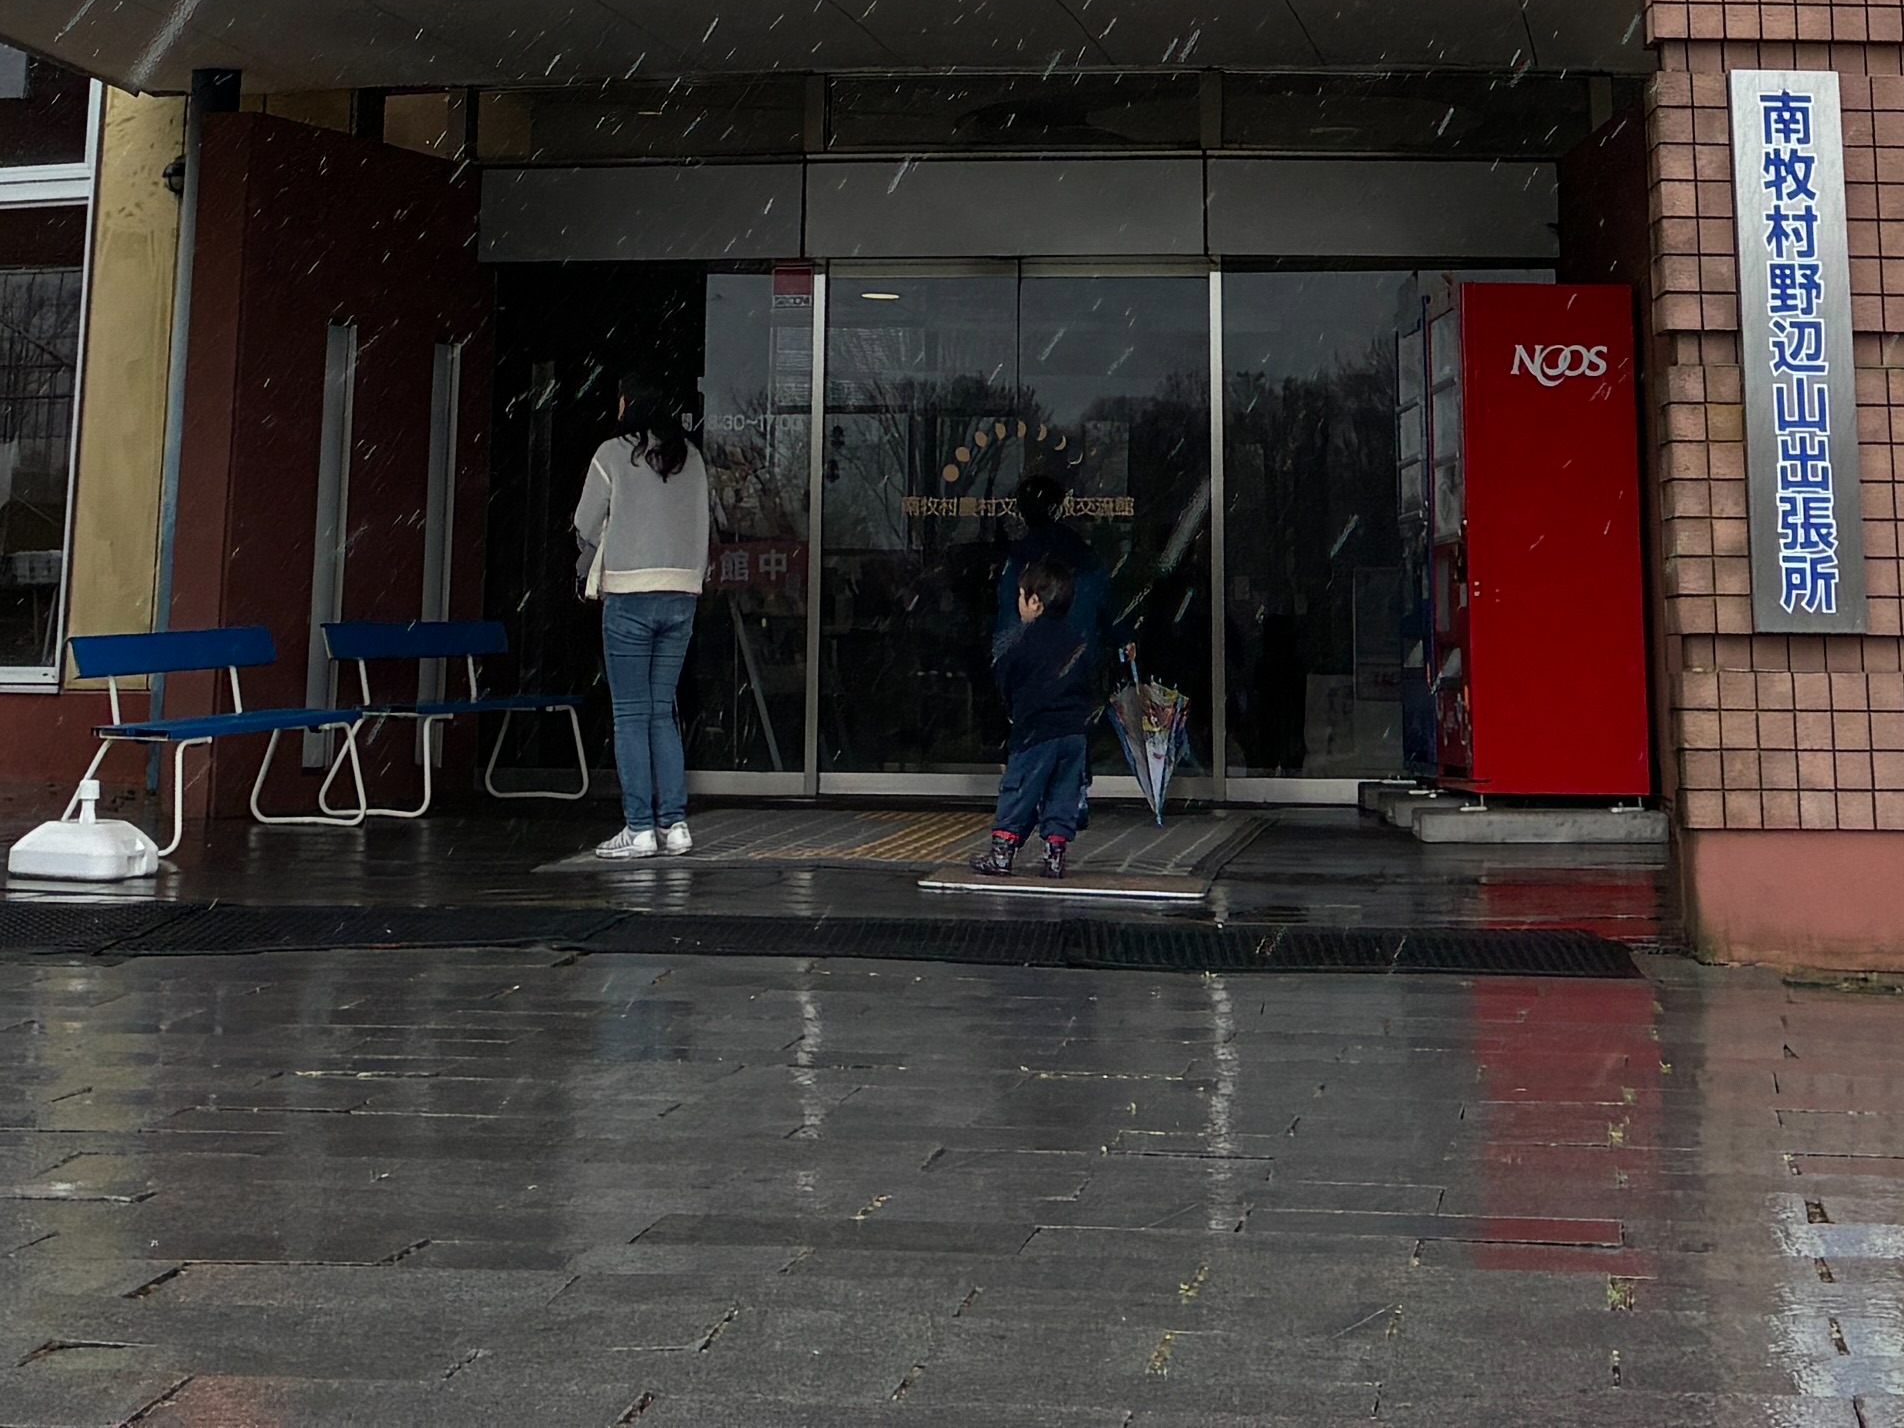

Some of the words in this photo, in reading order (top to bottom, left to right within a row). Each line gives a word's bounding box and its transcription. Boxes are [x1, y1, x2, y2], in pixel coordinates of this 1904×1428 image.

[1758, 88, 1839, 617] 南牧村野辺山出張所
